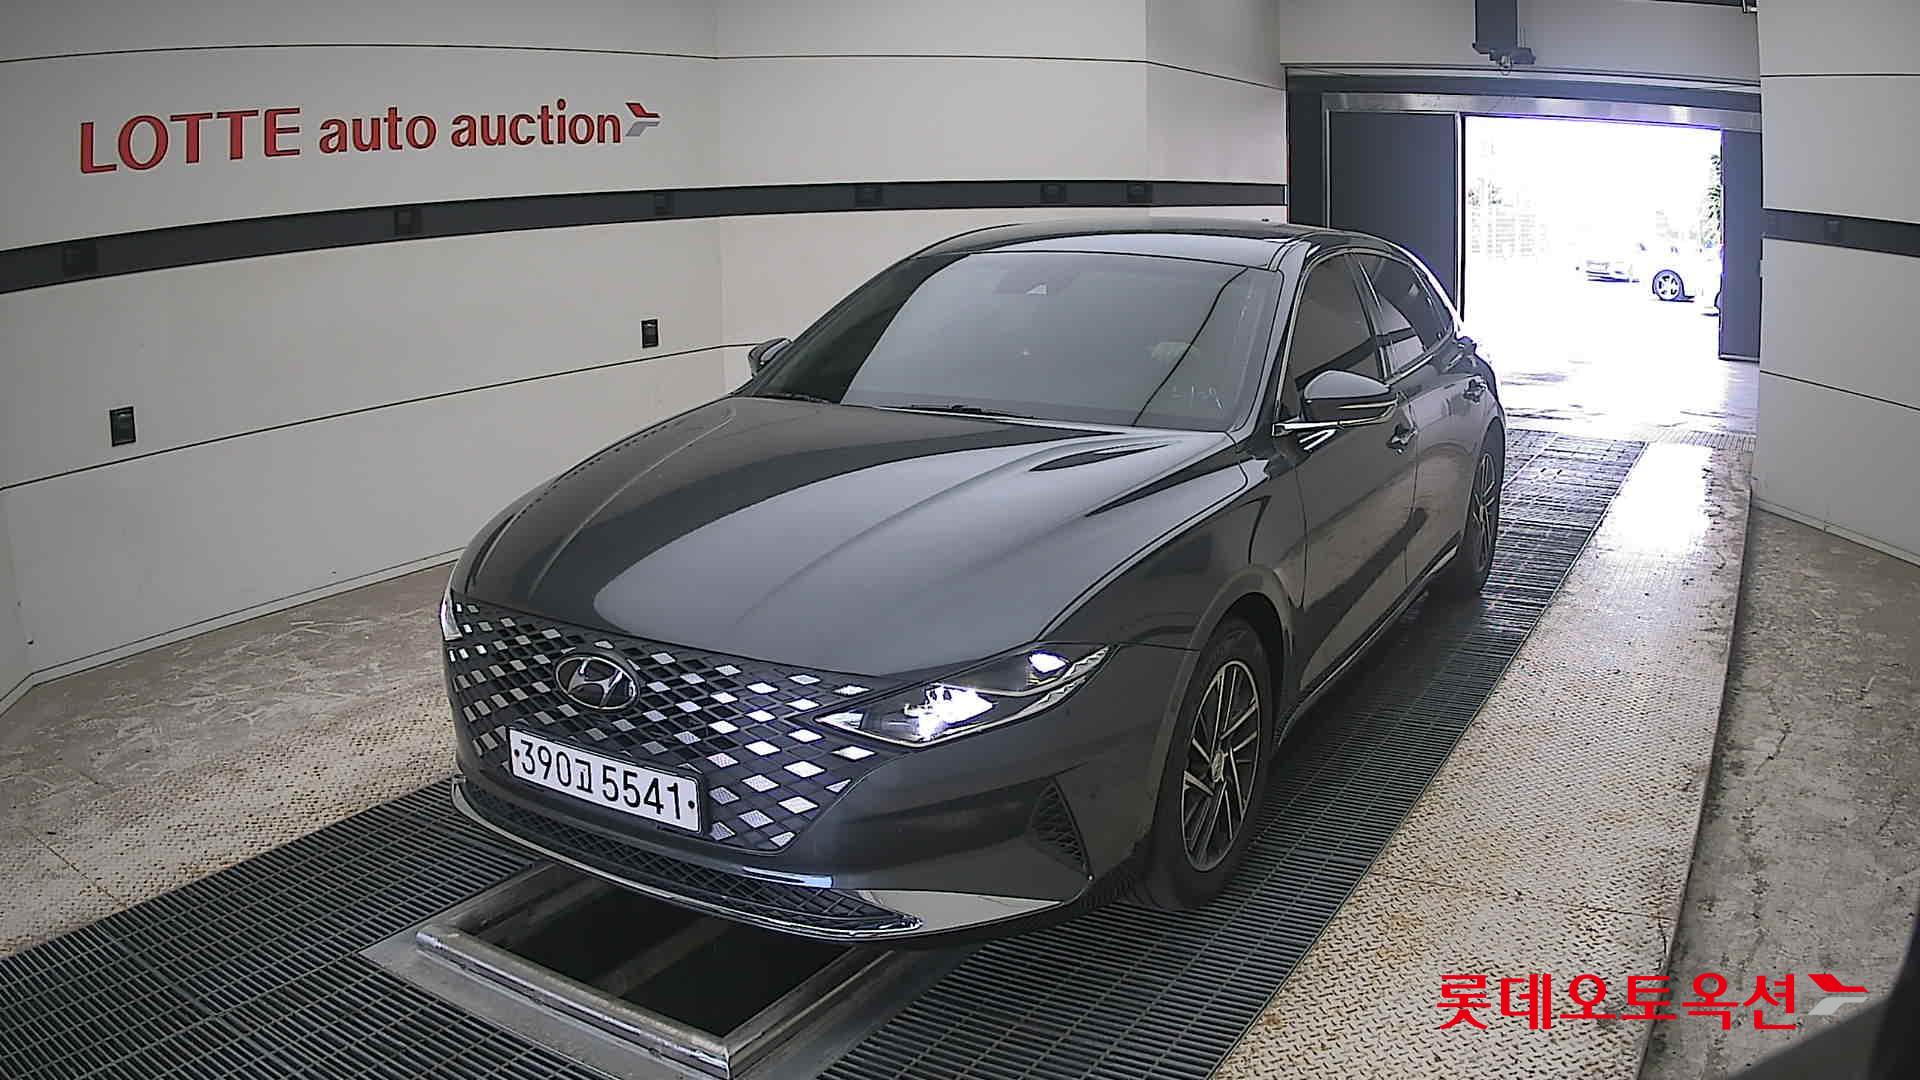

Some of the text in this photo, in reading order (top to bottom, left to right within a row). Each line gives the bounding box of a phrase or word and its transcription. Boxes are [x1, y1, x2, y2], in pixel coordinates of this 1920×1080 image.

[80, 99, 622, 174] LOTTE auto auction
